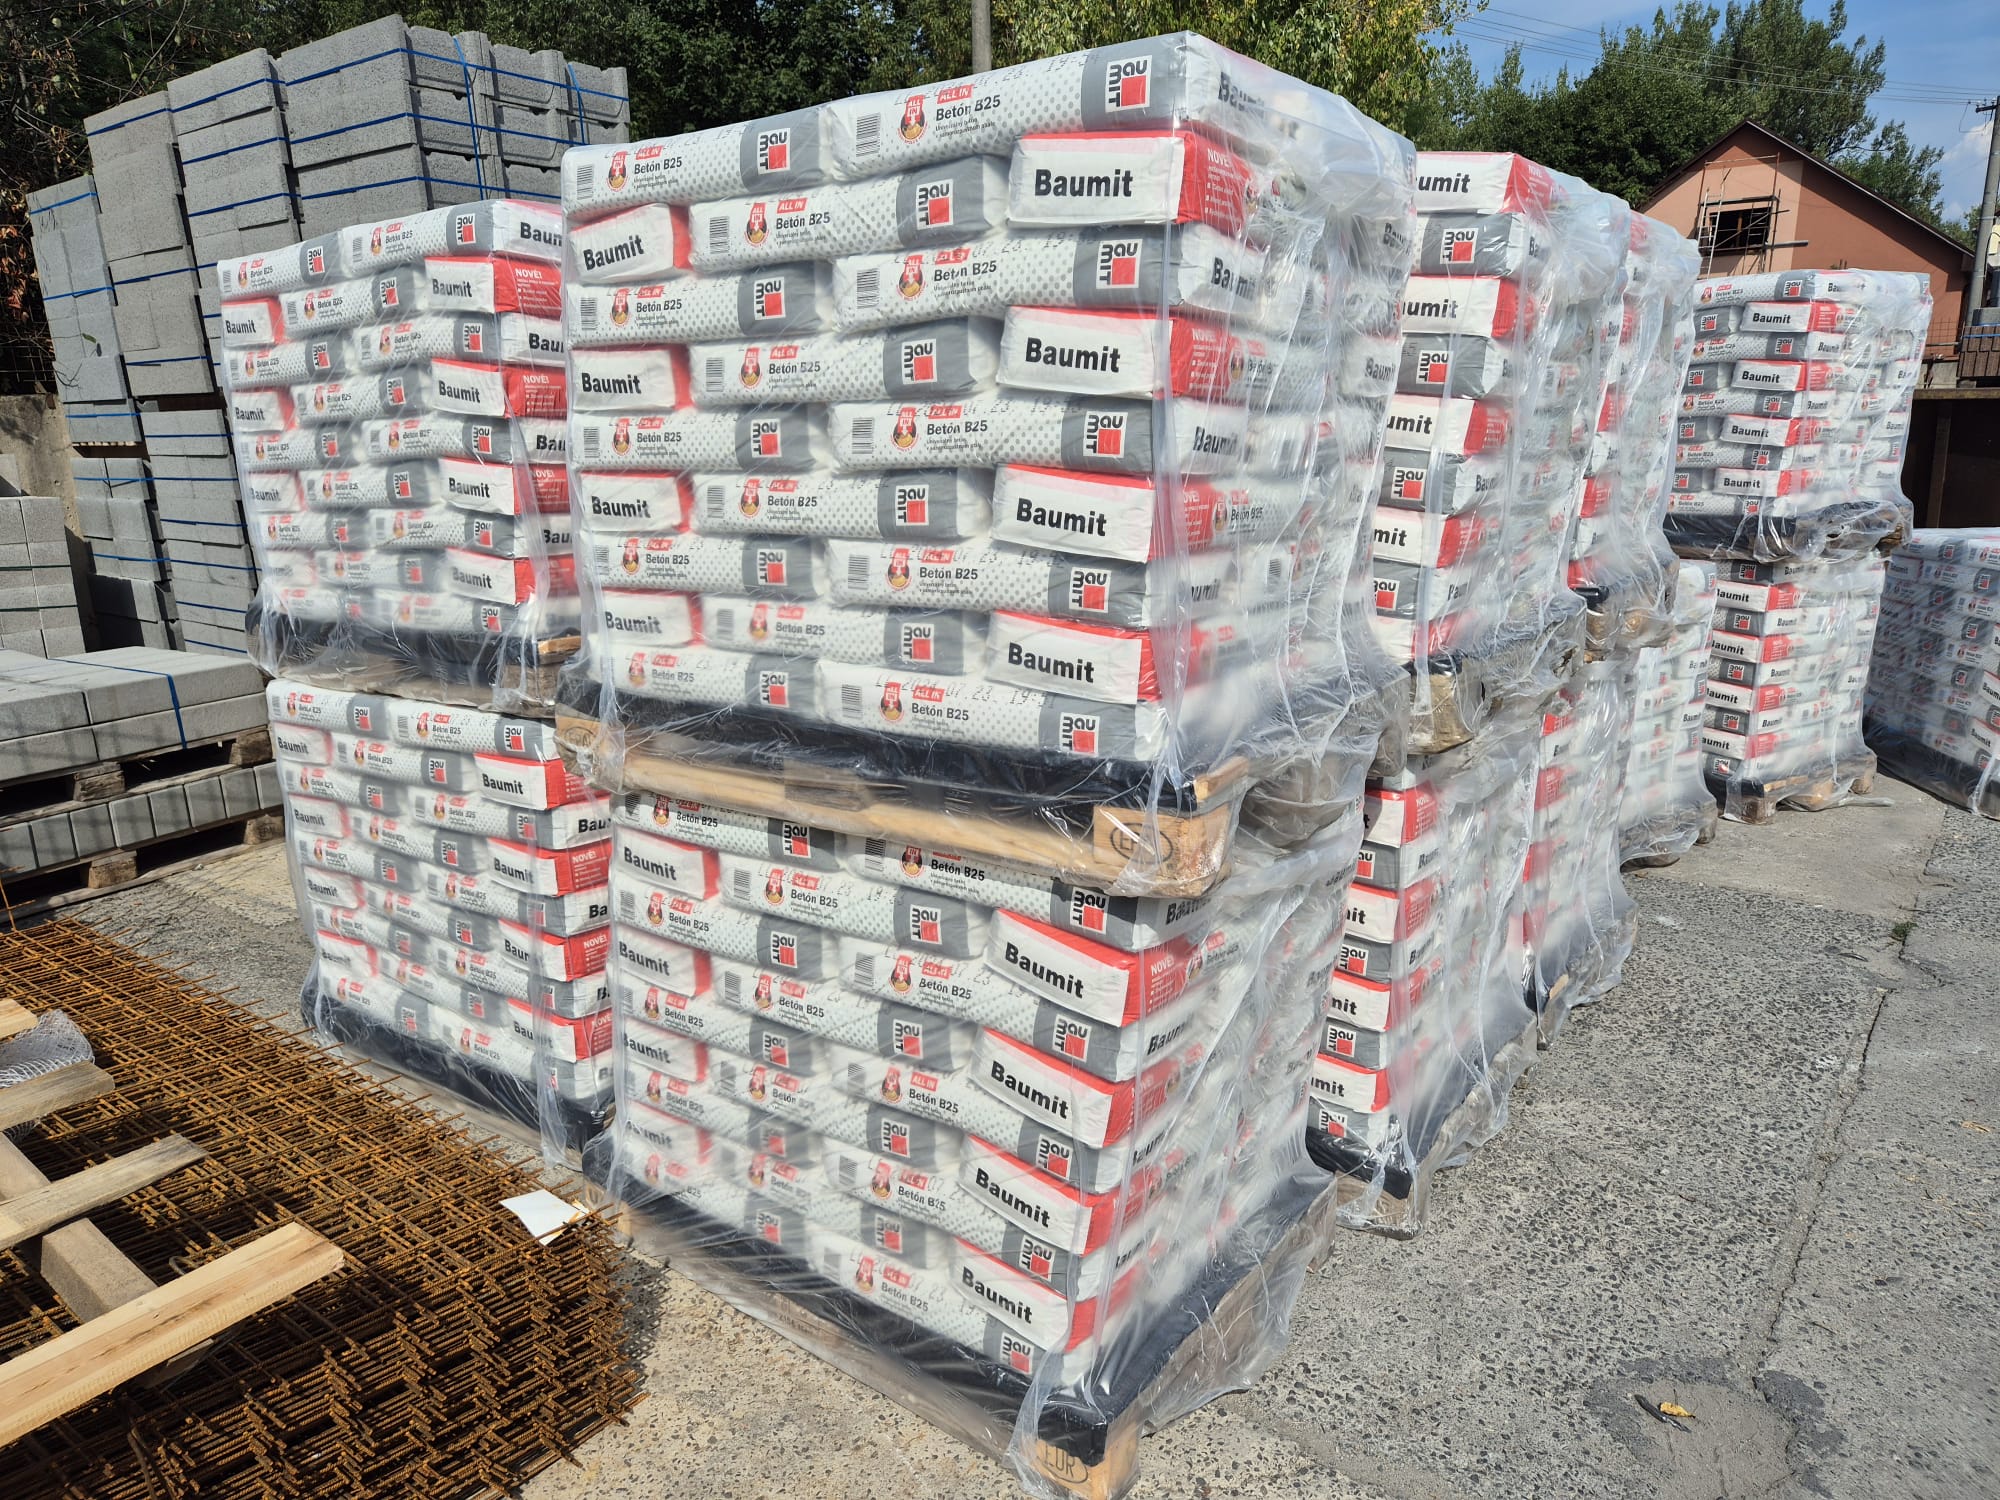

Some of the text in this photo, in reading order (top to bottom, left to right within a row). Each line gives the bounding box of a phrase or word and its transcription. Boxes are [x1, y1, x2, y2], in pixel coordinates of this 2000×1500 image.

[936, 95, 1000, 121] Betón B25
[634, 157, 682, 174] Betón B25
[1034, 168, 1133, 197] Baumit
[1415, 173, 1470, 193] umit
[776, 212, 831, 230] Betón B25
[520, 222, 562, 247] Baum
[583, 235, 644, 270] Baumit
[973, 260, 996, 275] B25
[433, 279, 472, 297] Baumit
[636, 300, 682, 313] Betón B25
[1402, 299, 1458, 319] umit
[226, 320, 256, 334] Baumit
[1753, 313, 1791, 324] Baumit
[529, 333, 563, 353] Bau
[1025, 338, 1120, 373] Baumit
[769, 362, 797, 374] Betón
[1742, 371, 1780, 383] Baumit
[439, 381, 480, 403] Baumit
[582, 373, 641, 394] Baumit
[235, 407, 265, 421] Baumit
[927, 420, 988, 435] Betón B25
[1387, 415, 1432, 434] umit
[1732, 426, 1769, 437] Baumit
[637, 432, 682, 443] Betón B25
[449, 477, 490, 498] Baumit
[1724, 478, 1760, 489] Baumit
[592, 496, 650, 518] Baumit
[768, 495, 817, 507] Betón B25
[1017, 498, 1106, 537] Baumit
[1374, 529, 1407, 547] mit
[647, 553, 689, 565] Betón B25
[453, 567, 492, 589] Baumit
[920, 567, 978, 580] Betón B25
[605, 612, 662, 634] Baumit
[805, 624, 825, 635] B25
[1008, 642, 1094, 683] Baumit
[677, 672, 694, 682] B25
[912, 703, 968, 720] Betón B25
[278, 737, 309, 754] Baumit
[1702, 738, 1730, 750] aumit
[482, 774, 524, 795] Baumit
[294, 810, 325, 826] Baumit
[677, 811, 718, 828] Betón B25
[494, 858, 534, 883] Baumit
[624, 847, 677, 881] Baumit
[931, 858, 985, 881] Betón B25
[791, 888, 838, 908] Betón B25
[694, 918, 709, 932] B25
[619, 941, 670, 976] Baumit
[1005, 942, 1084, 999] Baumit
[919, 978, 972, 1000] Betón B25
[779, 996, 824, 1018] Betón B25
[688, 1015, 703, 1028] B25
[991, 1061, 1068, 1119] Baumit
[1311, 1077, 1344, 1097] mit
[909, 1088, 959, 1114] Betón B25
[898, 1185, 925, 1205] Betón
[976, 1168, 1050, 1229] Baumit
[910, 1294, 929, 1312] B25
[963, 1267, 1033, 1324] Baumit
